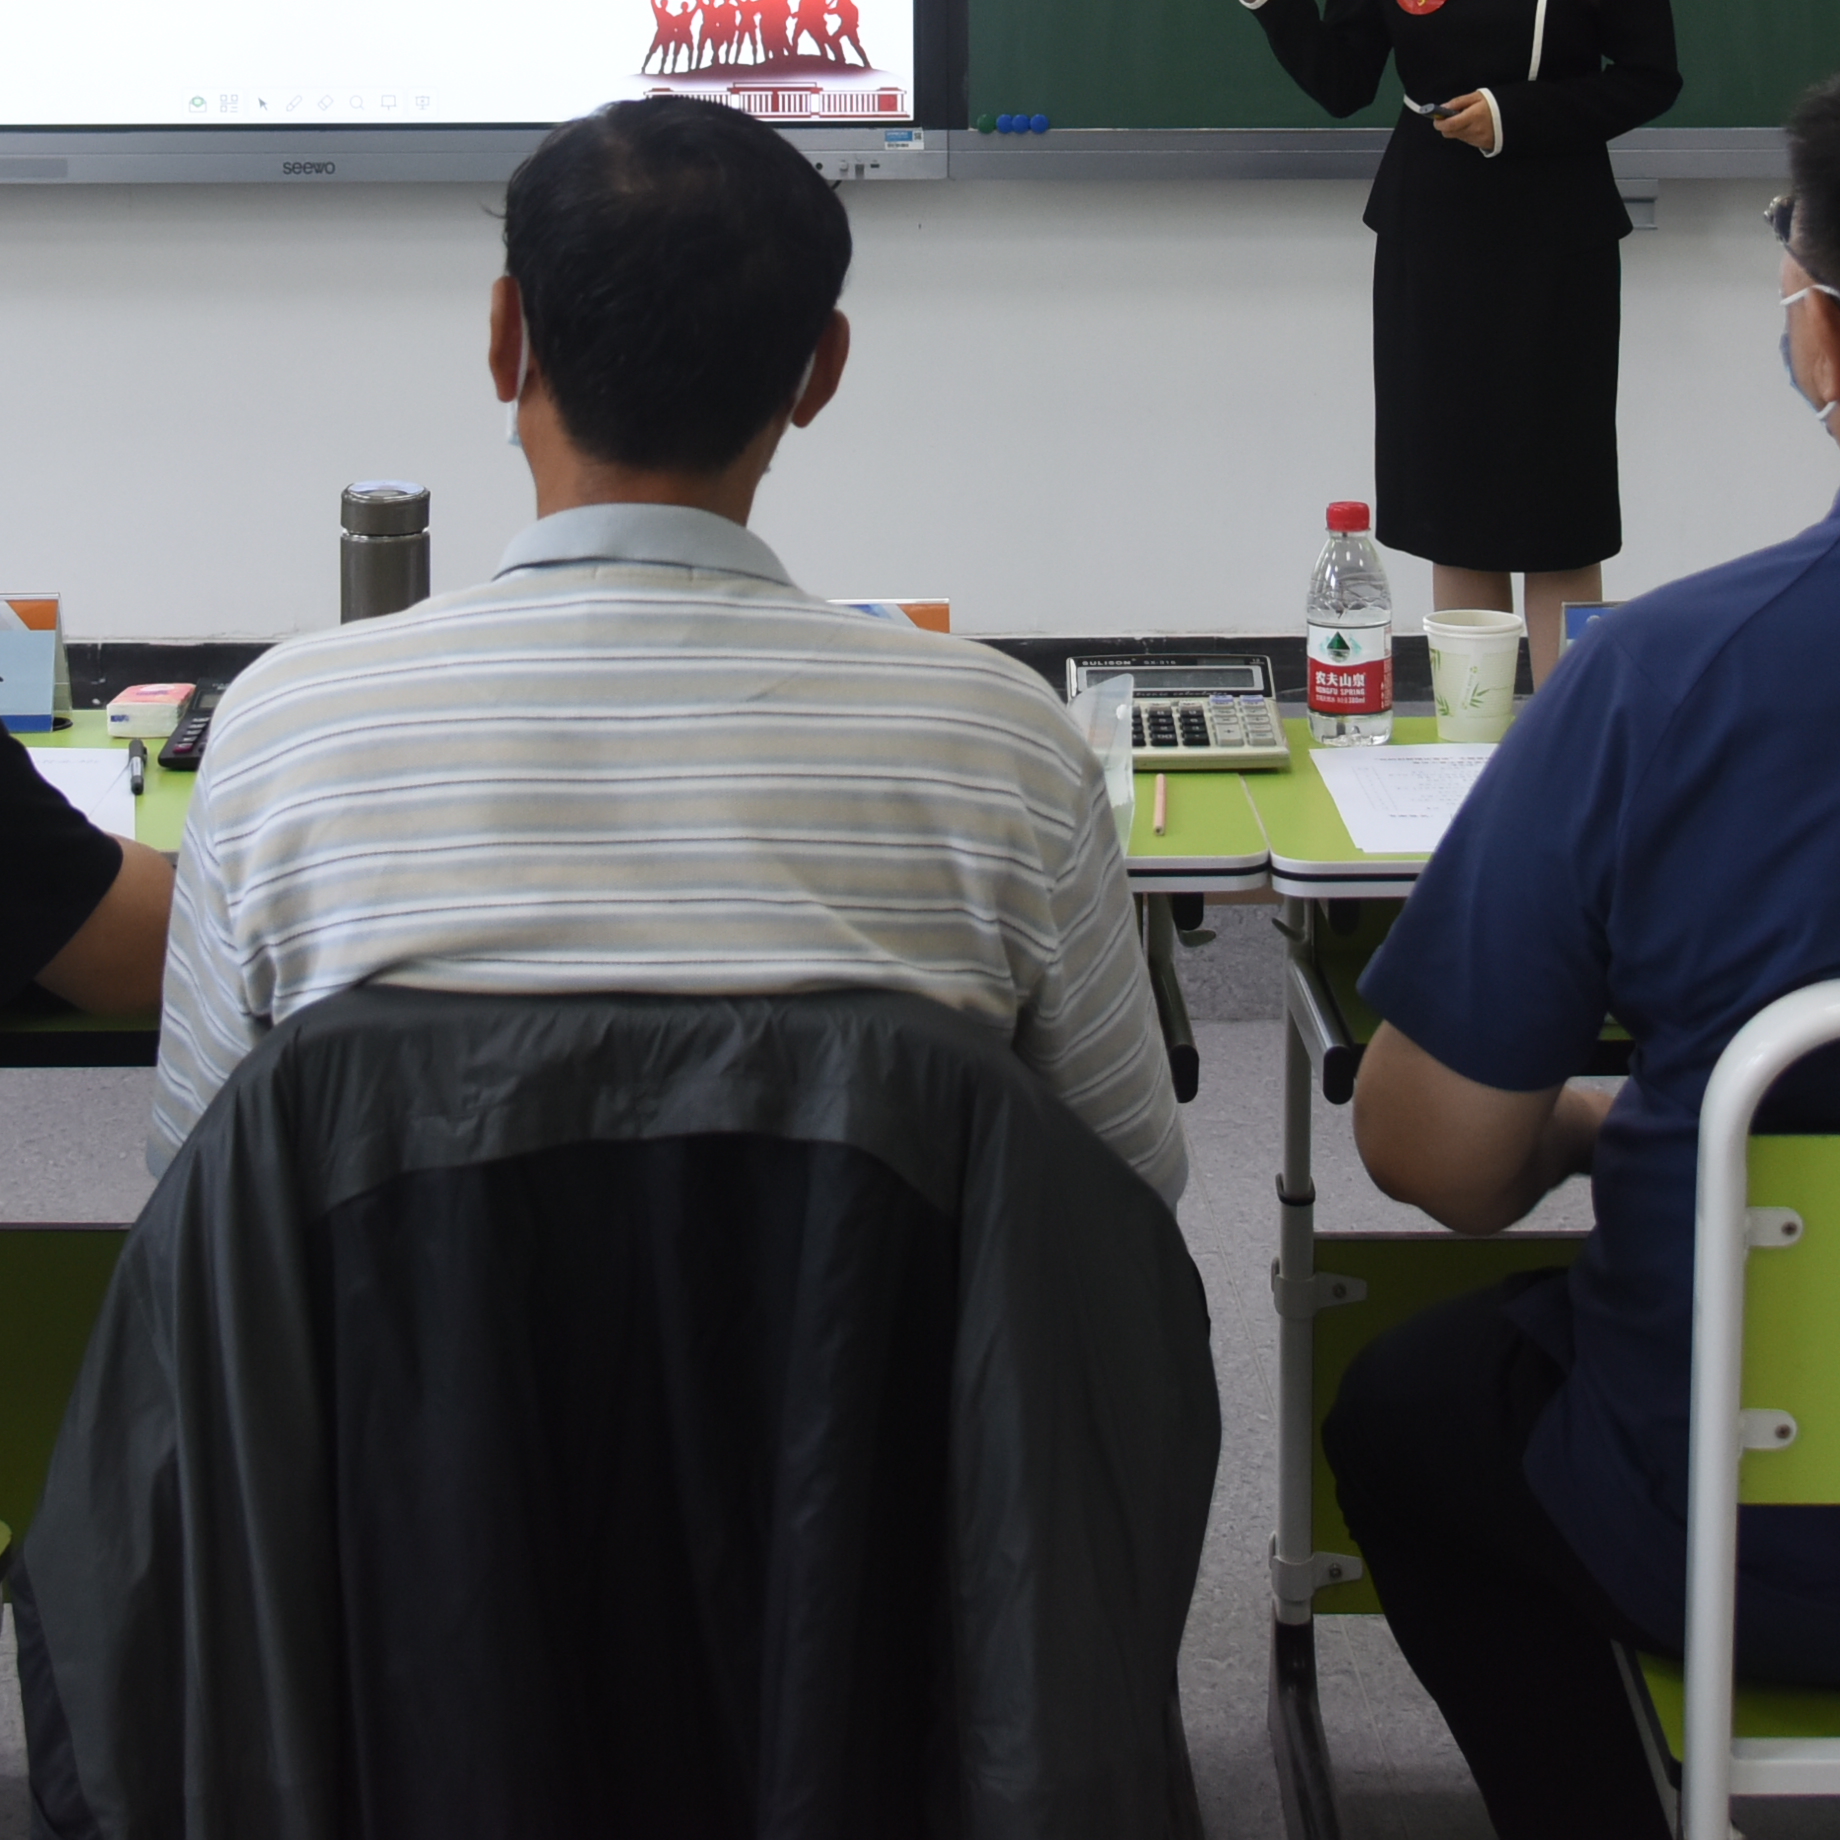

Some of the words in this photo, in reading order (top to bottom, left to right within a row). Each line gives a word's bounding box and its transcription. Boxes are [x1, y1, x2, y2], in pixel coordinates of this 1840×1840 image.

[282, 160, 336, 175] seewo
[1315, 670, 1366, 687] 农夫山泉
